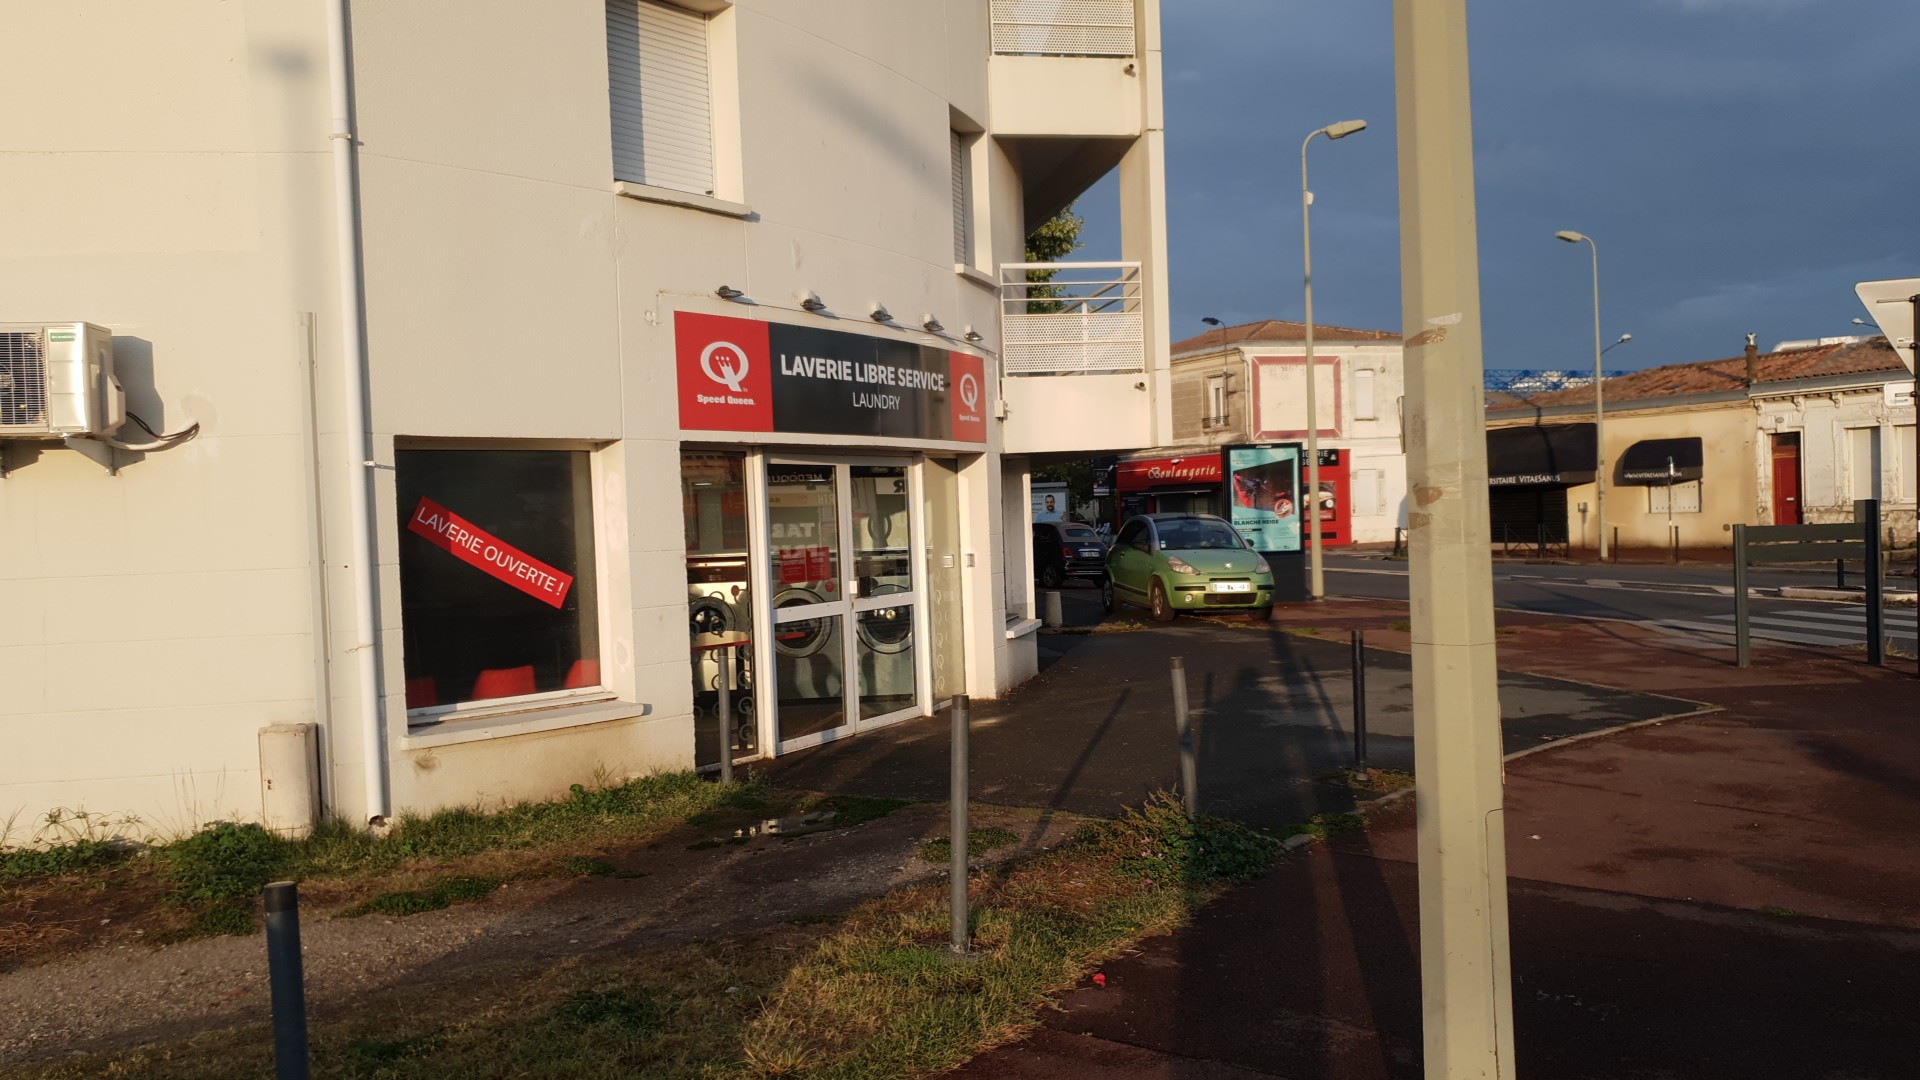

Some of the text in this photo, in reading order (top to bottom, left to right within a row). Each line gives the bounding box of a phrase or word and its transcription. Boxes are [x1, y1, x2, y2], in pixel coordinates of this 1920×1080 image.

[780, 354, 944, 392] LAVERIE LIBRE SERVICE
[697, 394, 754, 405] Speed Queen
[852, 391, 900, 410] LAUNDRY
[1148, 465, 1216, 480] Boulangerie
[417, 507, 484, 554] LAVERIE
[484, 545, 557, 592] OUVERTE
